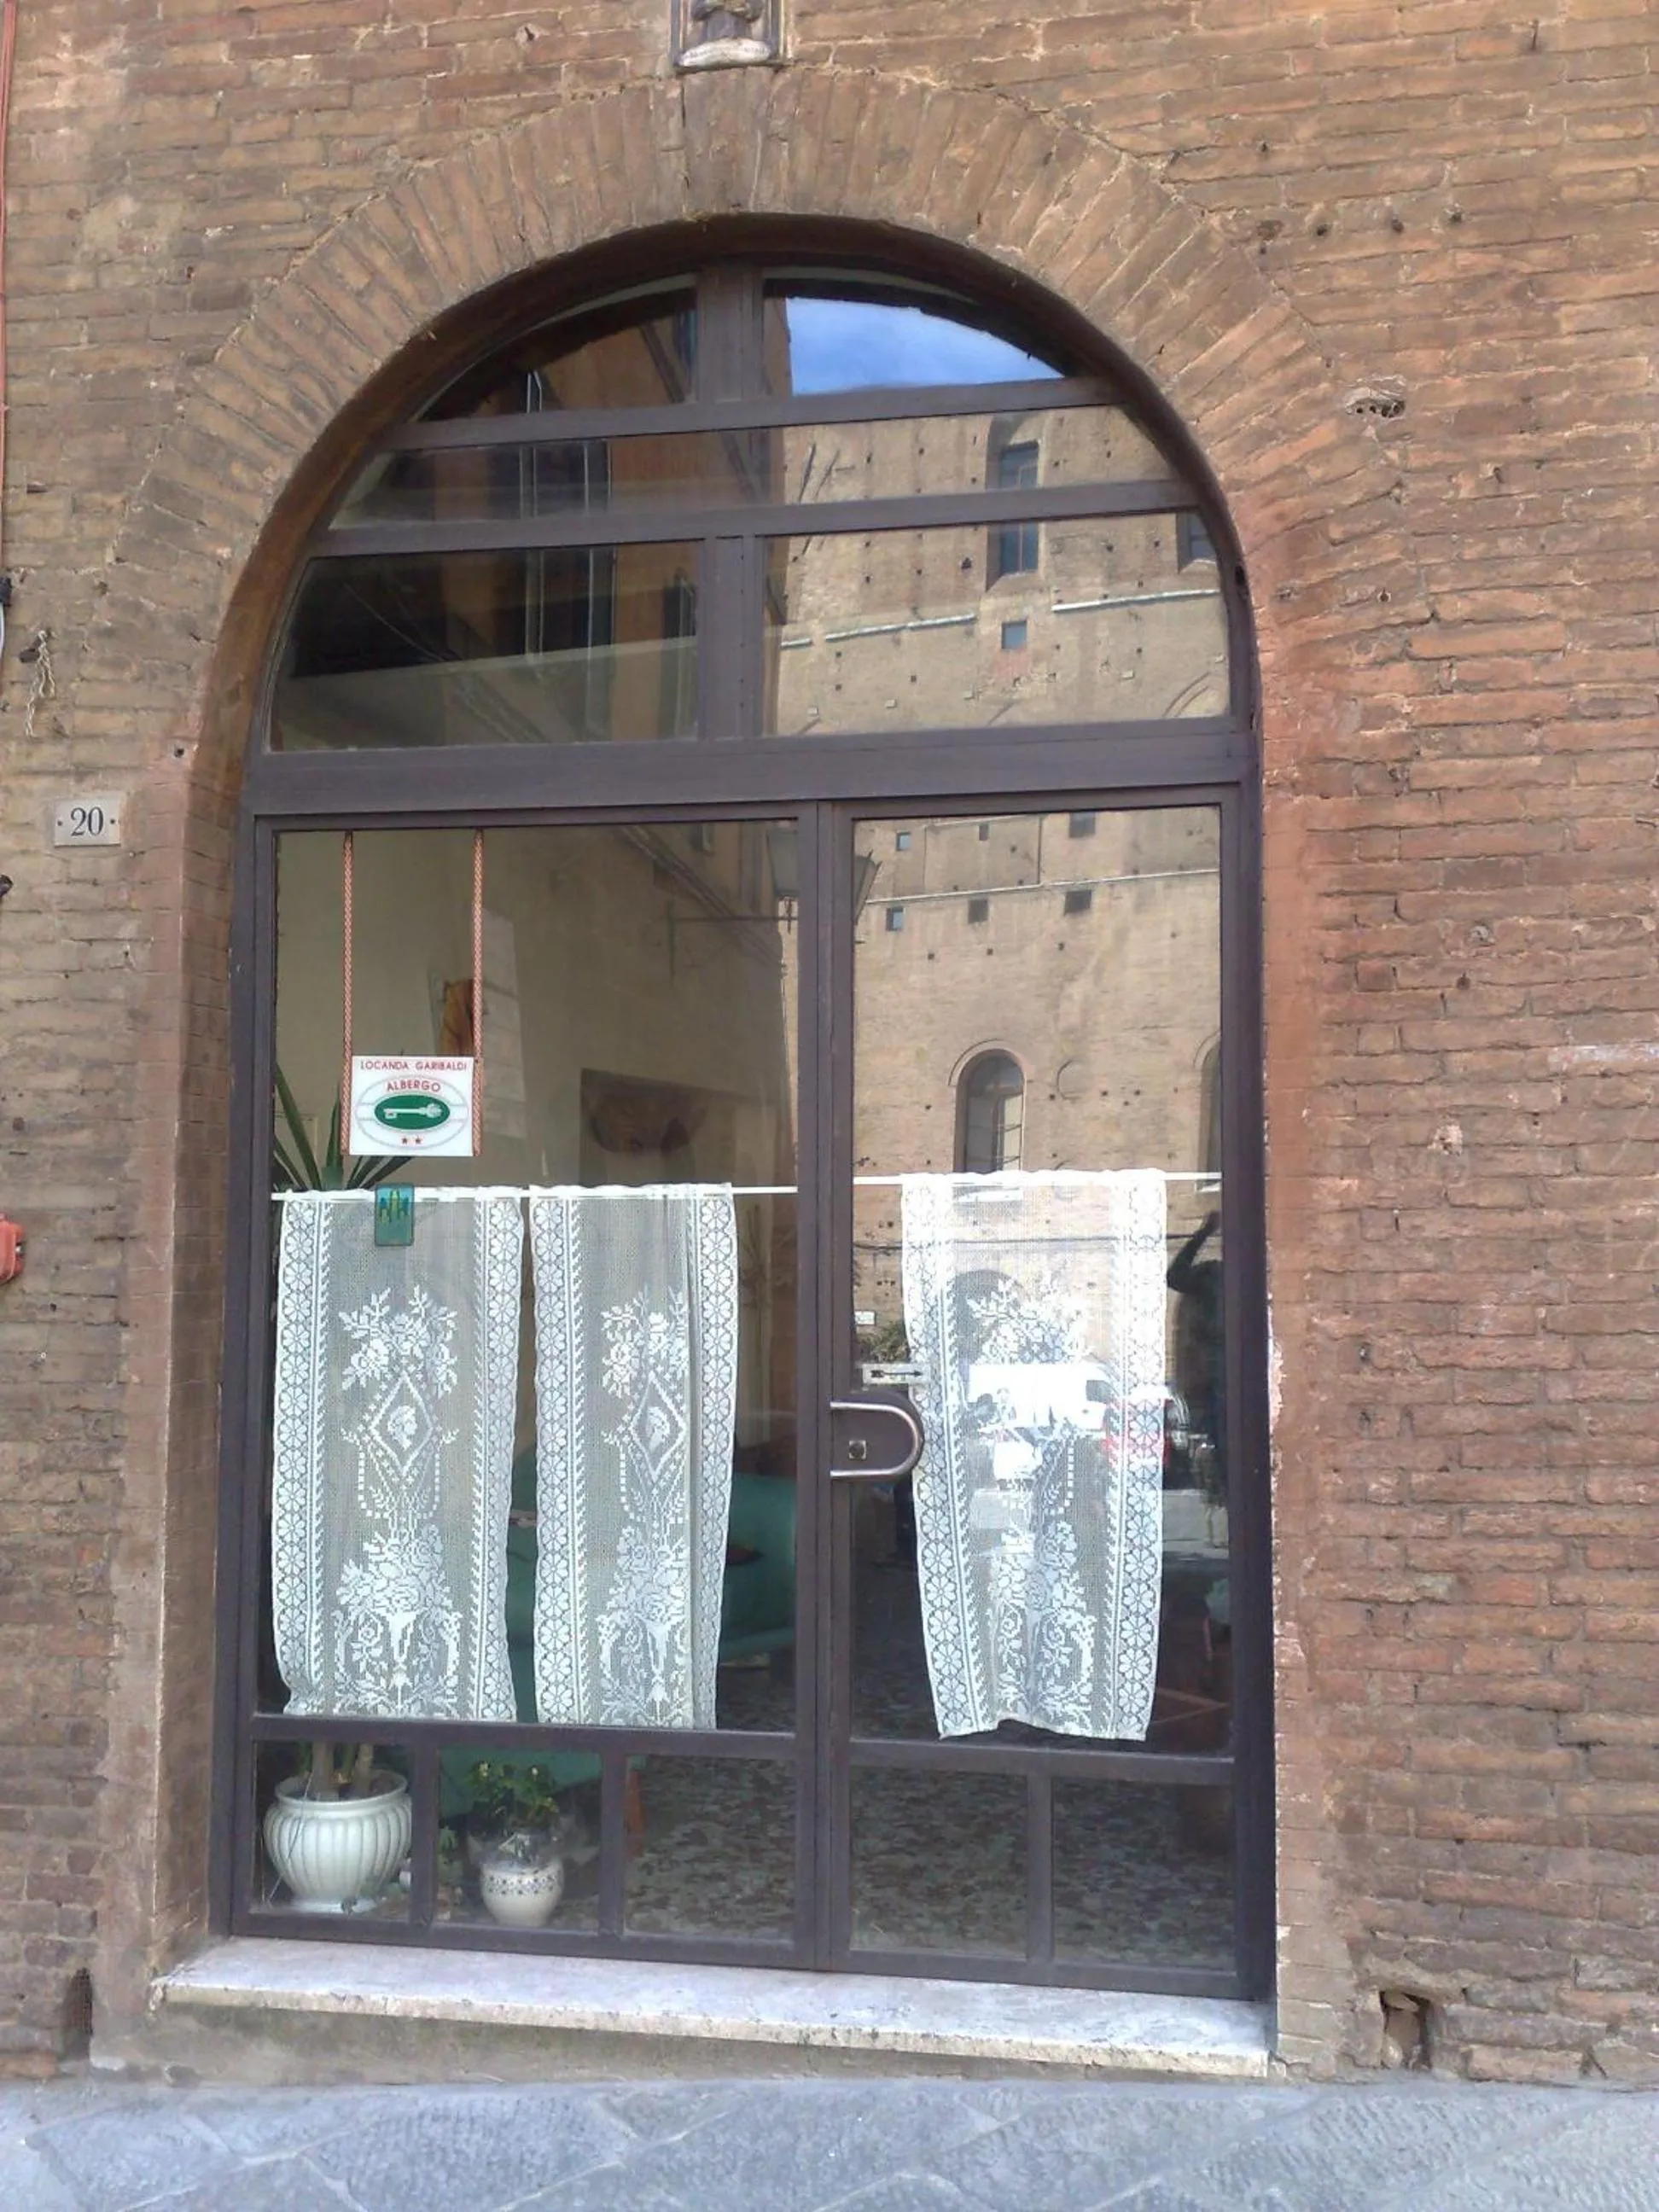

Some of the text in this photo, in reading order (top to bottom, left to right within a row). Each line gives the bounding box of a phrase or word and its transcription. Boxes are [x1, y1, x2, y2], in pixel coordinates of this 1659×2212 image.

[70, 806, 104, 836] 20
[360, 1061, 468, 1071] LOCANDA GARIBALDI
[387, 1079, 441, 1092] ALBERGO
